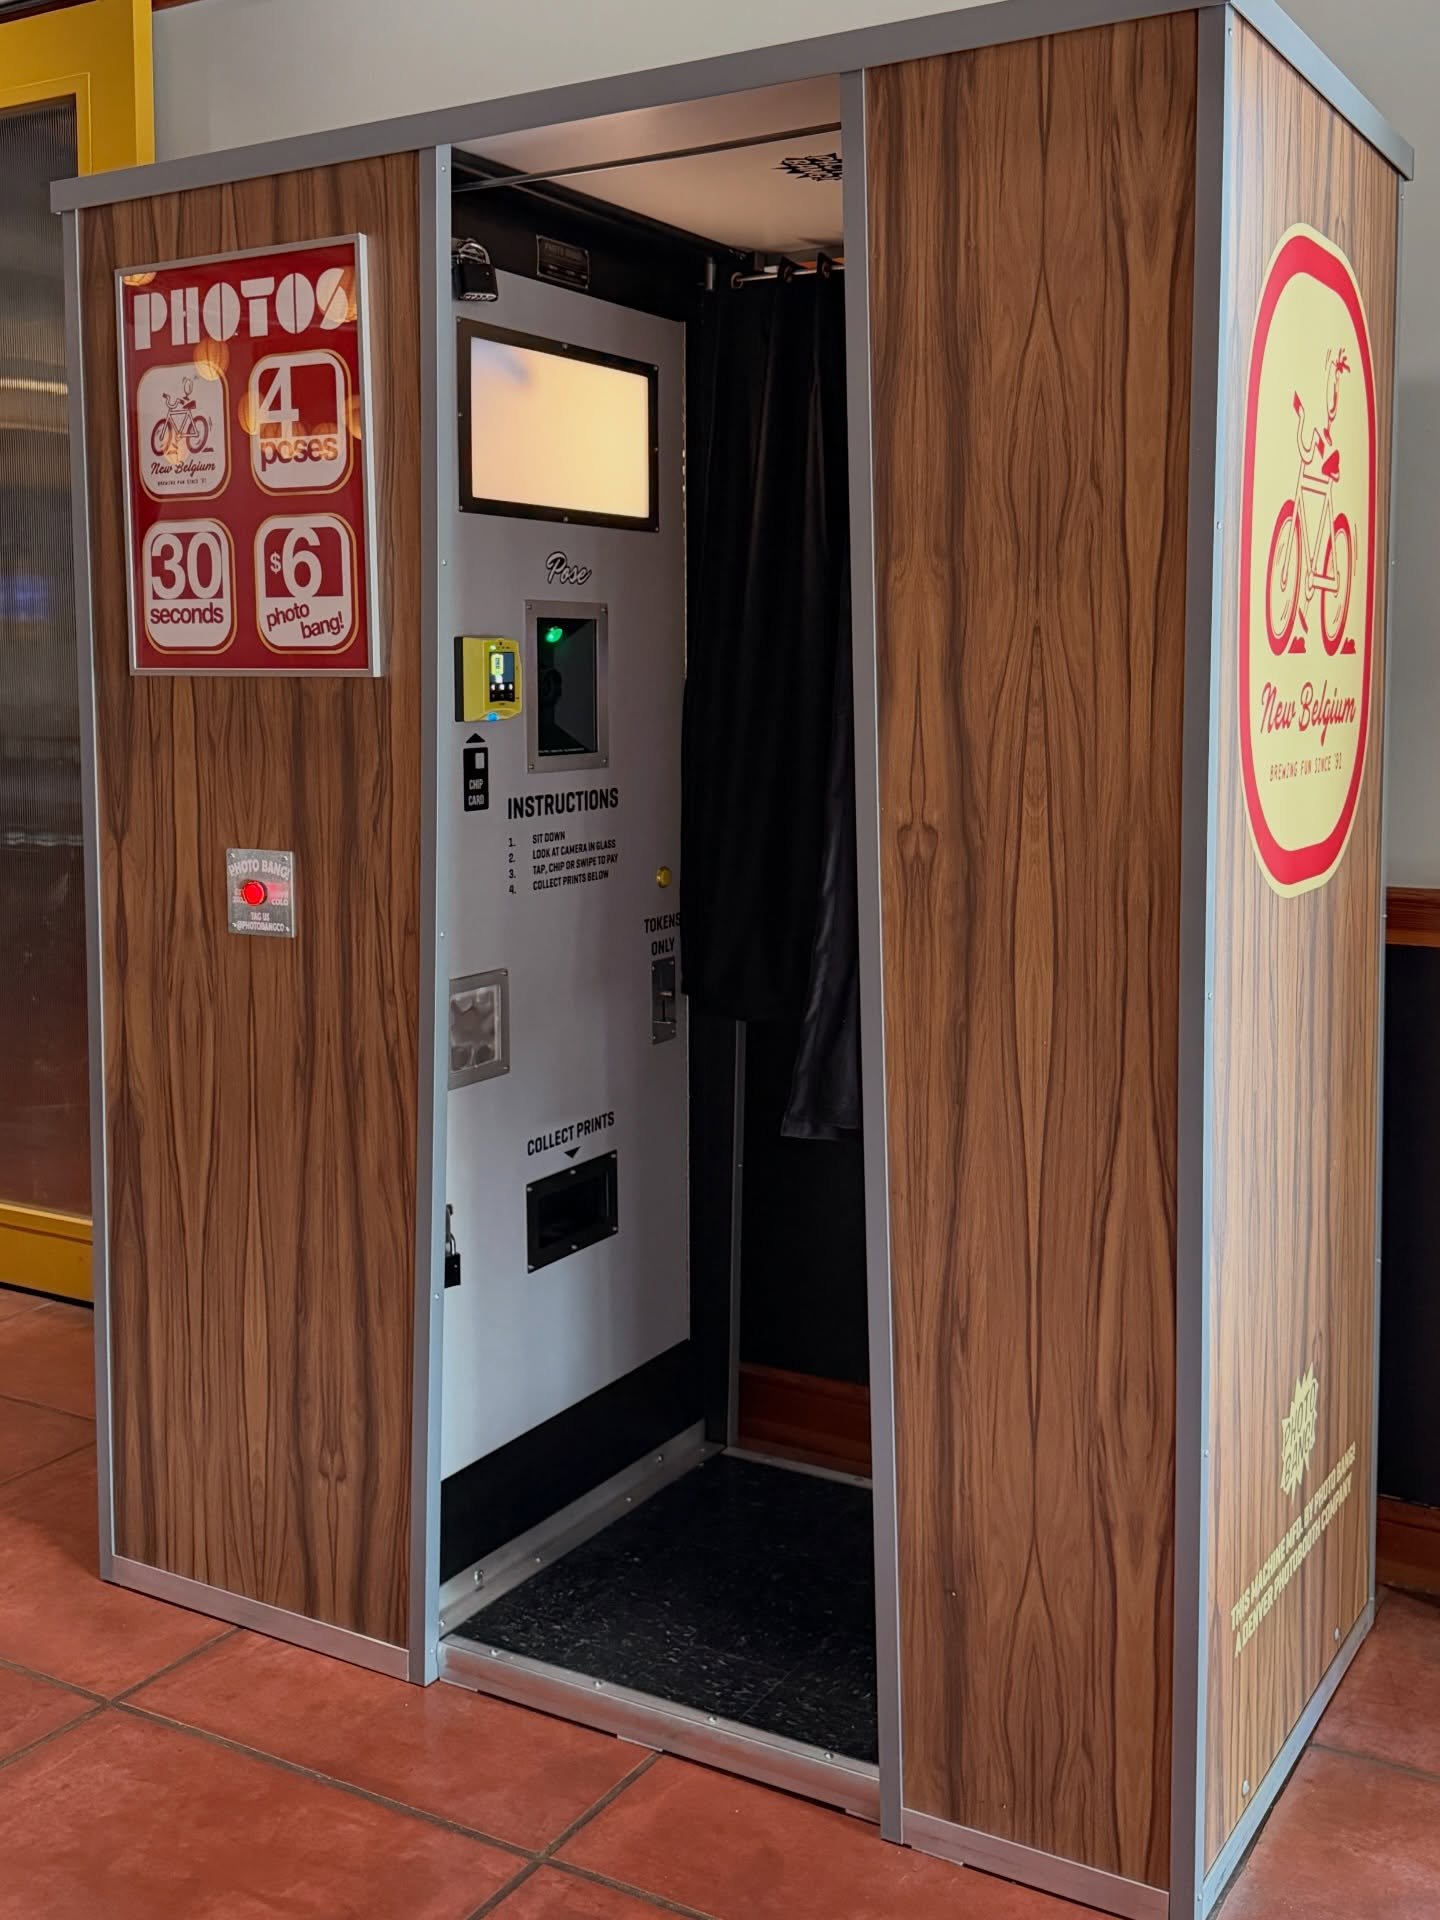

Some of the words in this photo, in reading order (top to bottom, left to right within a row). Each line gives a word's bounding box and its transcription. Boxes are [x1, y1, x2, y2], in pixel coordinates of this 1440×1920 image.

[133, 268, 347, 351] PHOTOS
[260, 365, 300, 437] 4
[151, 462, 172, 475] New
[174, 459, 216, 477] Belgium
[260, 437, 338, 472] poses
[151, 531, 223, 600] 30
[269, 527, 323, 599] $6
[546, 551, 592, 585] Pose
[150, 602, 224, 625] seconds
[266, 602, 310, 631] photo
[299, 611, 345, 640] bang!
[1260, 681, 1296, 734] New
[1298, 680, 1356, 747] Belgium
[1269, 761, 1298, 782] BREWING
[1300, 759, 1312, 777] FUN
[1314, 755, 1331, 774] SINCE
[468, 778, 484, 790] CHIP
[468, 794, 485, 806] CARD
[507, 787, 619, 820] INSTRUCTIONS
[532, 834, 543, 844] SIT
[544, 831, 566, 843] DOWN
[532, 848, 551, 860] LOOK
[551, 847, 560, 857] AT
[560, 843, 587, 856] CAMERA
[588, 841, 595, 851] IN
[595, 839, 617, 850] GLASS
[228, 859, 260, 877] PHOTO
[532, 865, 548, 875] TAP,
[548, 861, 565, 873] CHIP
[565, 860, 575, 870] OR
[575, 856, 597, 869] SWIPE
[597, 855, 606, 865] TO
[606, 853, 619, 864] PAY
[532, 877, 562, 891] COLLECT
[562, 873, 587, 886] PRINTS
[587, 869, 610, 882] BELOW
[250, 912, 261, 920] TAG
[262, 912, 270, 921] US
[644, 912, 681, 934] TOKENS
[651, 936, 675, 956] ONLY
[527, 1124, 574, 1156] COLLECT
[576, 1111, 615, 1138] PRINTS
[1284, 1381, 1316, 1448] PHOTO
[1230, 1586, 1250, 1632] THIS
[1250, 1537, 1285, 1605] MACHINE
[1303, 1497, 1314, 1529] BY
[1314, 1468, 1336, 1514] PHOTO
[1234, 1631, 1241, 1658] A
[1242, 1585, 1274, 1648] DENVER
[1273, 1516, 1321, 1601] PHOTOBOOTH
[1321, 1471, 1352, 1531] COMPANY
